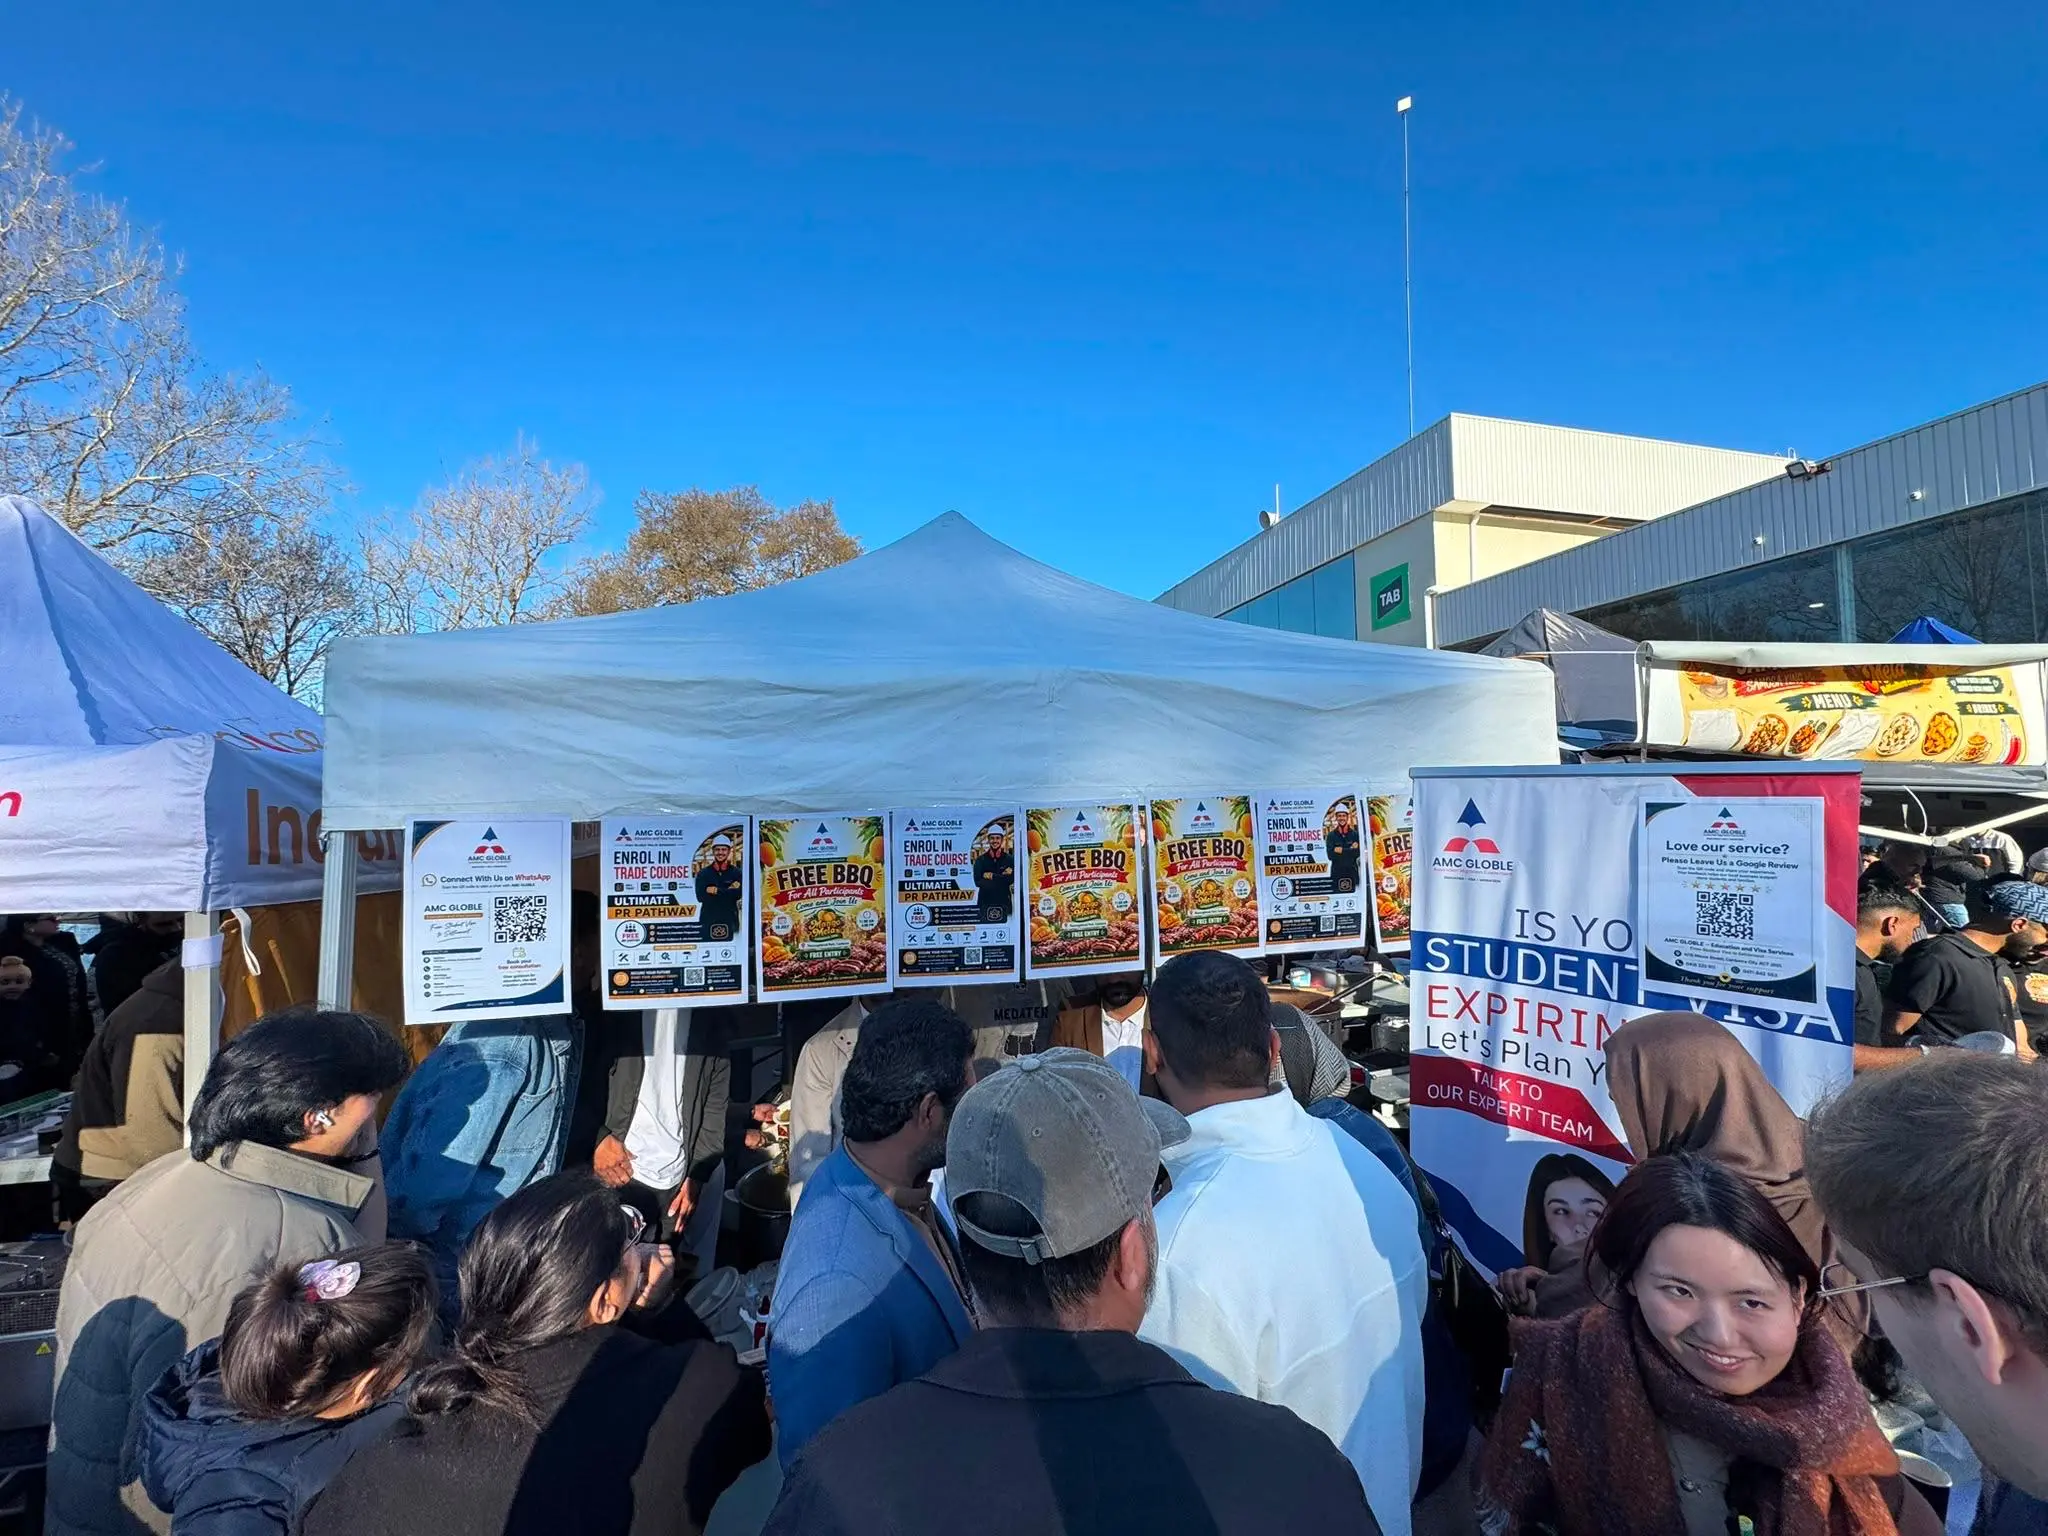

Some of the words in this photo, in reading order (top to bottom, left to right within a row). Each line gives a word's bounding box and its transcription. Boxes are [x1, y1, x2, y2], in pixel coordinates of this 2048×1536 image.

[1380, 589, 1401, 607] TAB
[1812, 693, 1852, 709] MENU
[1267, 819, 1296, 830] ENROL
[1298, 818, 1307, 829] IN
[1268, 831, 1292, 842] TRADE
[1293, 829, 1321, 841] COURSE
[904, 840, 938, 853] ENROL
[941, 840, 952, 852] IN
[1167, 839, 1208, 862] FREE
[1212, 839, 1244, 860] BBQ
[1383, 834, 1412, 855] FRE
[1666, 840, 1698, 852] Love
[1701, 843, 1723, 852] our
[1728, 843, 1790, 855] service?
[614, 851, 651, 864] ENROL
[658, 851, 671, 863] IN
[904, 854, 933, 866] TRADE
[935, 853, 968, 865] COURSE
[1042, 850, 1086, 874] FREE
[1091, 849, 1125, 871] BBQ
[1269, 855, 1309, 864] ULTIMATE
[1433, 857, 1462, 868] AMC
[1465, 859, 1514, 871] GLOBLE
[1661, 856, 1688, 864] Please
[1690, 858, 1715, 866] Leave
[1736, 860, 1767, 869] Google
[1767, 861, 1799, 869] Review
[614, 866, 647, 879] TRADE
[653, 866, 689, 879] COURSE
[1270, 866, 1282, 875] PR
[1284, 864, 1327, 874] PATHWAY
[515, 873, 551, 882] WhatsApp
[776, 865, 828, 890] FREE
[833, 864, 874, 889] BBQ
[1052, 875, 1065, 883] For
[1066, 872, 1077, 881] All
[1079, 870, 1118, 880] Participants
[904, 882, 952, 890] ULTIMATE
[788, 891, 803, 900] For
[804, 888, 818, 897] All
[819, 886, 864, 896] Participants
[904, 893, 919, 901] PR
[922, 891, 974, 900] PATHWAY
[614, 896, 670, 905] ULTIMATE
[830, 898, 847, 906] Join
[848, 896, 858, 904] Us
[615, 908, 630, 917] PR
[635, 907, 694, 917] PATHWAY
[1515, 908, 1556, 942] IS
[1572, 914, 1633, 952] YO
[1711, 942, 1740, 950] Education
[1681, 976, 1700, 984] Thank
[1746, 986, 1775, 995] support
[1427, 984, 1627, 1052] EXPIRIN
[1426, 1025, 1492, 1058] Let's
[1502, 1039, 1571, 1079] Plan
[1471, 1067, 1510, 1094] TALK
[1516, 1080, 1542, 1101] TO
[1427, 1084, 1463, 1101] OUR
[1469, 1090, 1534, 1121] EXPERT
[1538, 1110, 1593, 1141] TEAM
